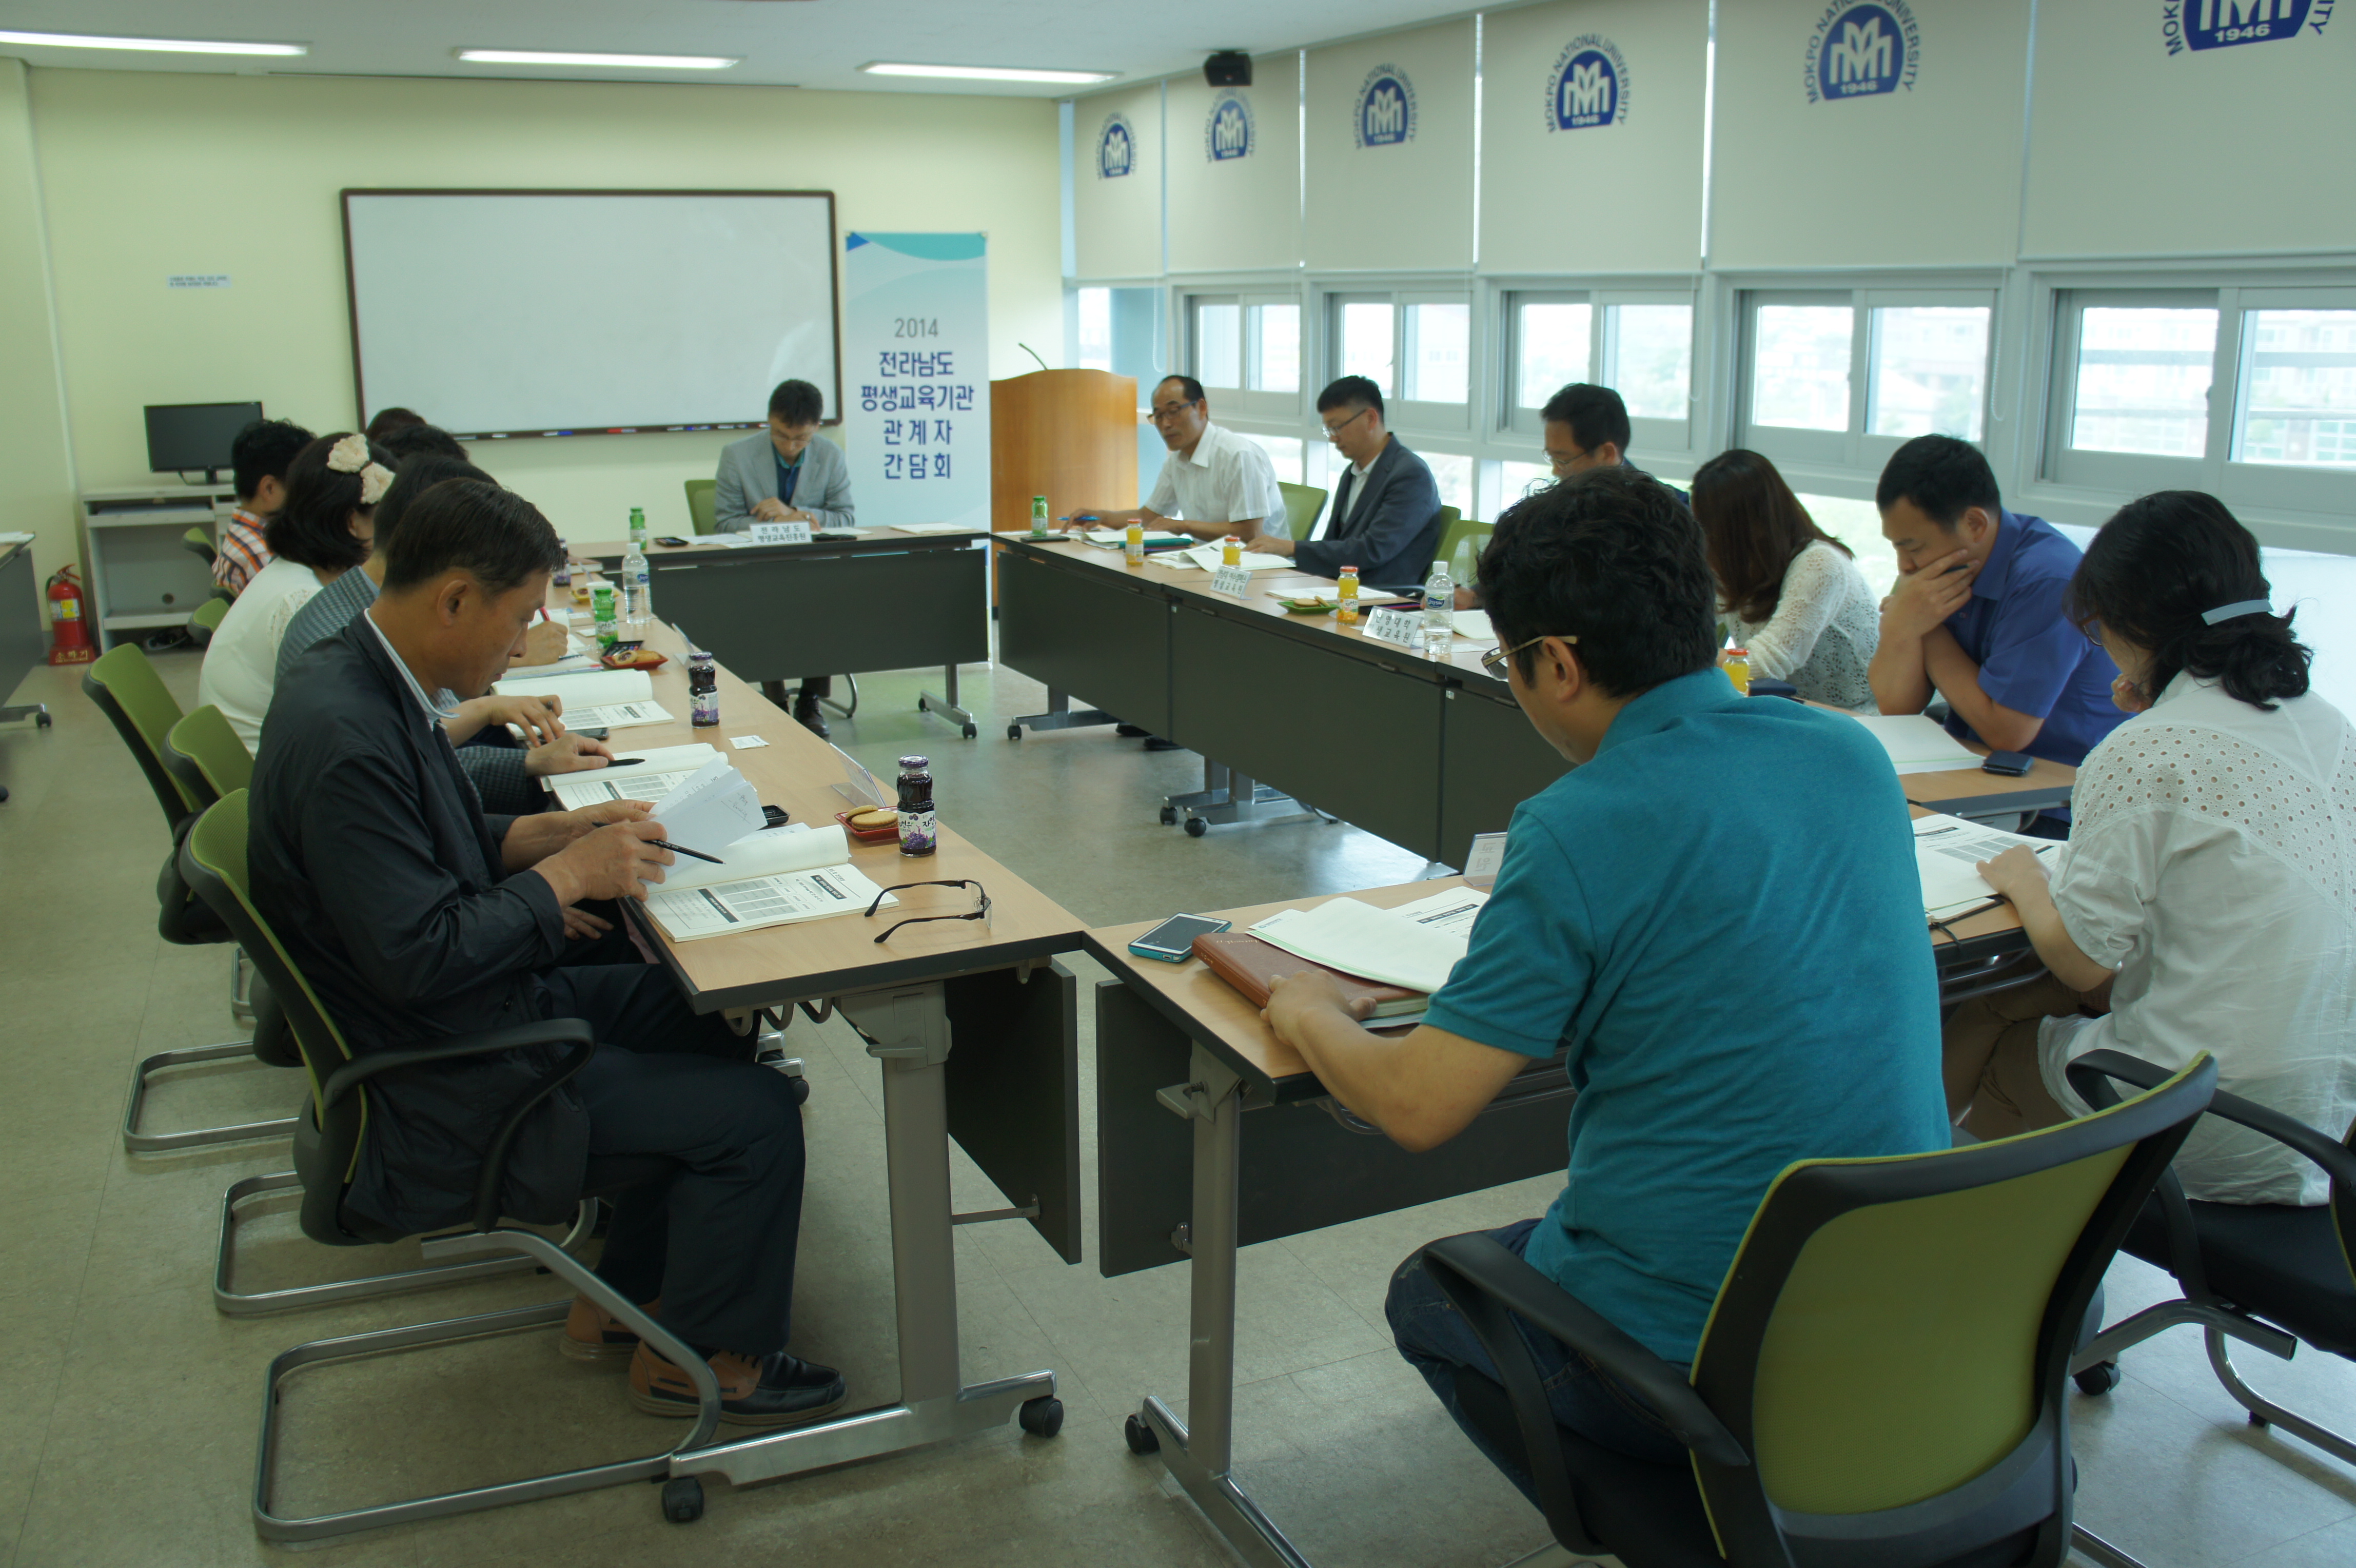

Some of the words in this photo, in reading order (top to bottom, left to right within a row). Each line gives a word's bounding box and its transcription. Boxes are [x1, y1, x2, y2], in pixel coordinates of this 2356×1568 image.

[2163, 0, 2184, 56] MOK
[2214, 24, 2271, 43] 1946
[1804, 35, 1821, 105] MOKPO
[1840, 80, 1878, 95] 1946
[894, 318, 939, 339] 2014
[879, 351, 954, 379] 전라남도
[860, 384, 975, 413] 평생교육기관
[883, 419, 953, 446] 관계자
[883, 452, 952, 480] 간담회
[1368, 623, 1410, 643] 생교육원
